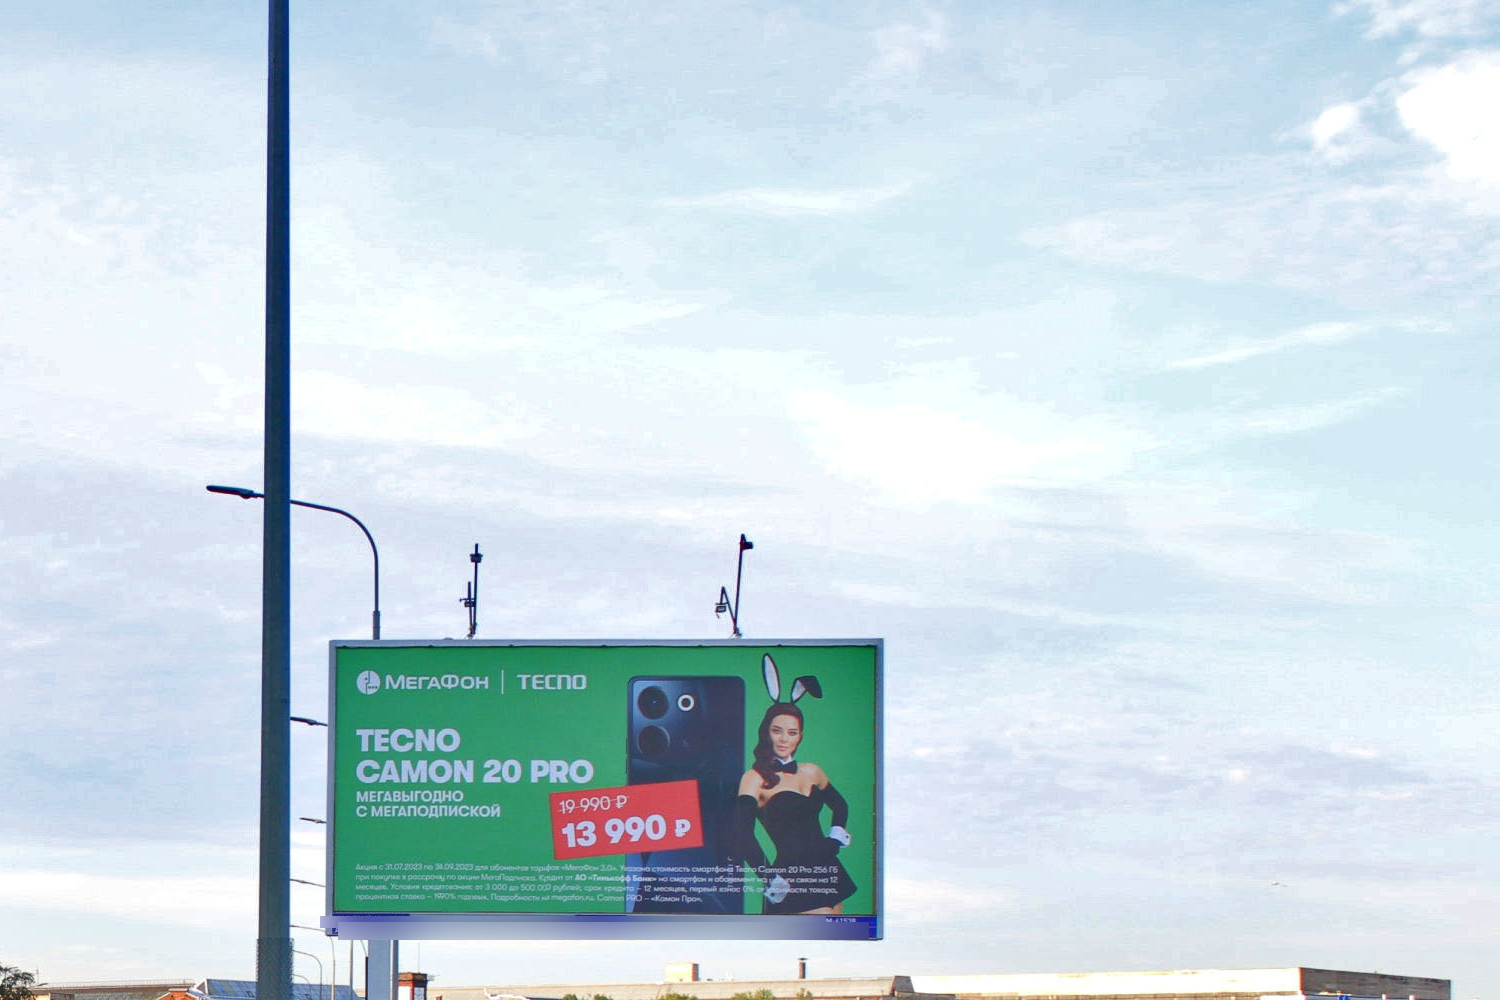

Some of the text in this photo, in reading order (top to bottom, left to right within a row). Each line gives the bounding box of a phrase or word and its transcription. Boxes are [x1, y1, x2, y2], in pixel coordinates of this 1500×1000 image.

[517, 674, 588, 690] TECNO
[356, 728, 461, 752] TECNO
[356, 760, 594, 783] CAMON 20 PRO
[356, 790, 464, 804] МЕГАВЫГОДНО
[356, 803, 501, 818] С МЕГАПОДПИСКОЙ
[559, 799, 575, 814] 19
[580, 796, 611, 812] 990
[562, 821, 597, 848] 13
[604, 814, 667, 844] 990
[691, 864, 734, 874] смартфона
[812, 865, 828, 873] 256
[370, 874, 401, 882] покупке
[407, 874, 445, 882] рассрочку
[456, 874, 480, 882] акции
[669, 874, 706, 883] смартфон
[643, 883, 652, 891] 12
[688, 884, 717, 893] первый
[742, 884, 755, 892] 0%
[490, 892, 540, 902] Подробности
[596, 893, 624, 901] Camon
[625, 893, 642, 901] PRO
[650, 893, 680, 901] «Камон
